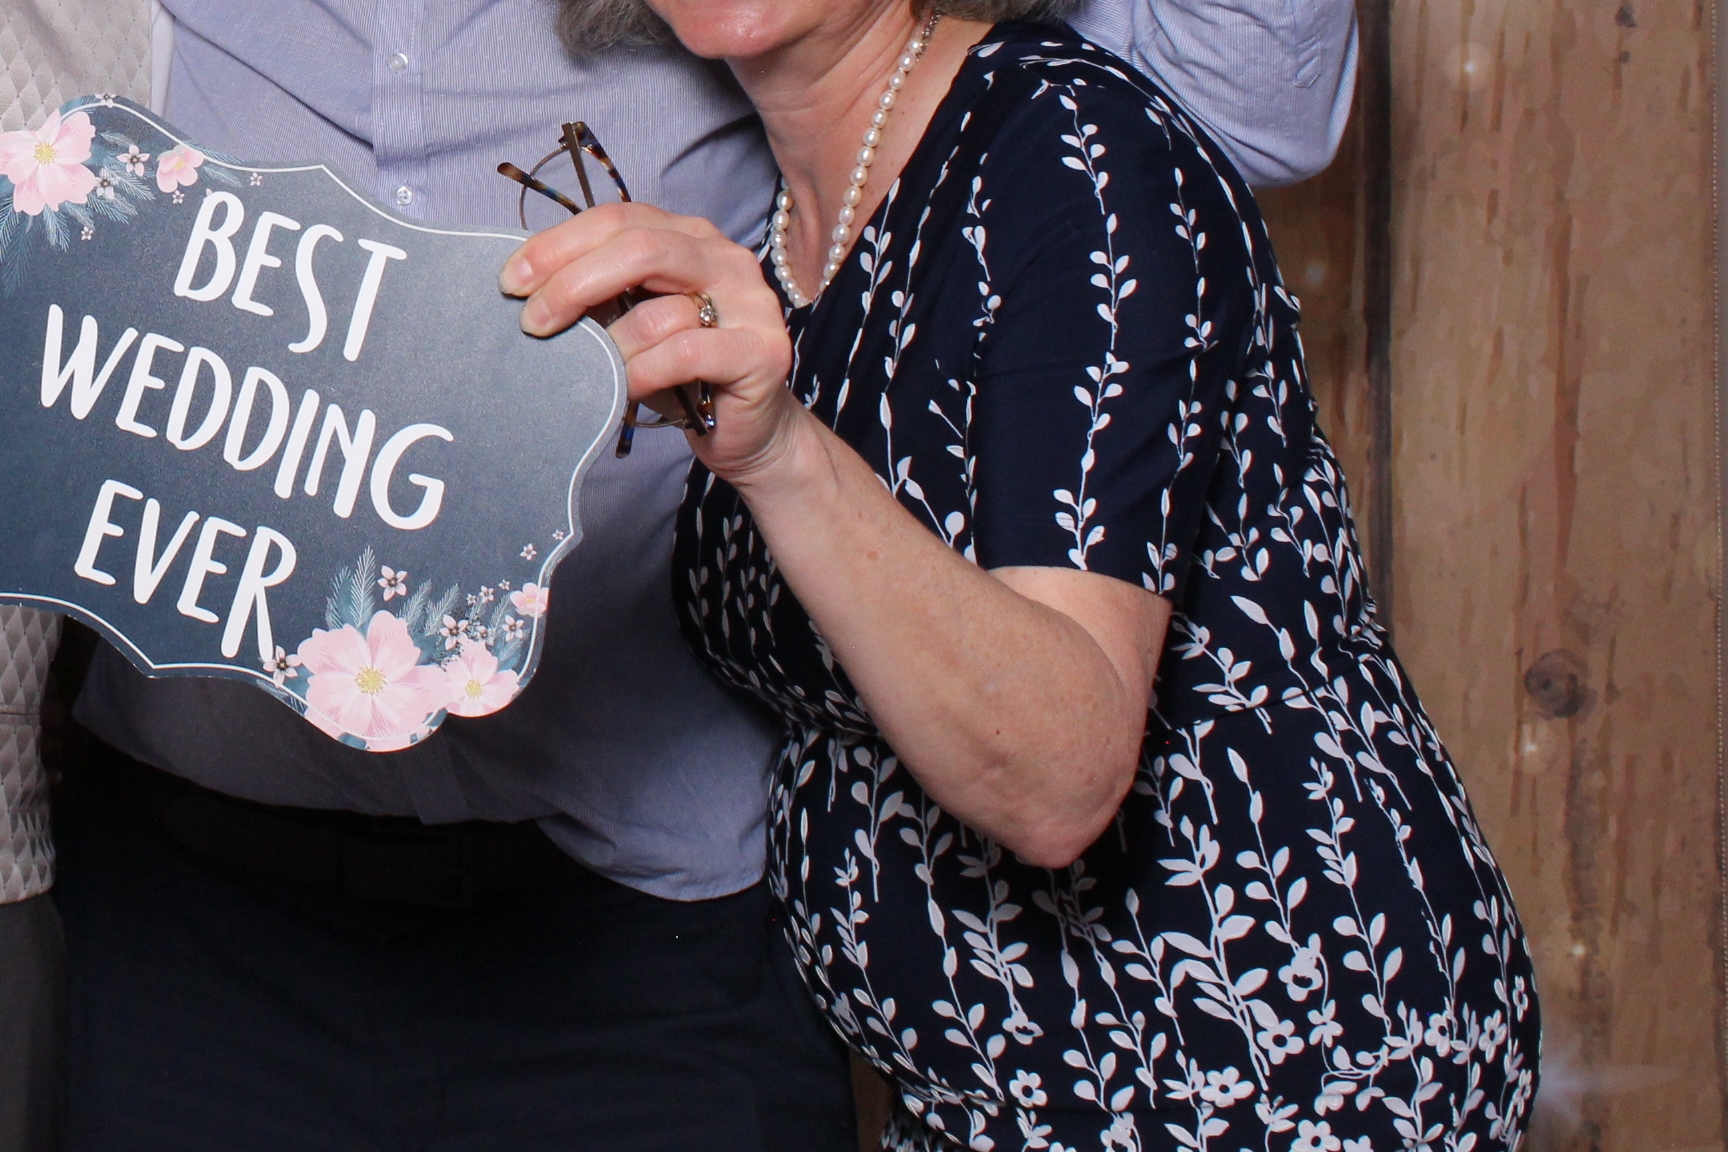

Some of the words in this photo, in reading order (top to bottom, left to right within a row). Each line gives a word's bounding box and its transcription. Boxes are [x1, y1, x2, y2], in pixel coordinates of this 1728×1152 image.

[173, 189, 408, 363] BEST
[40, 303, 455, 531] WEDDING
[73, 479, 298, 664] EVER
